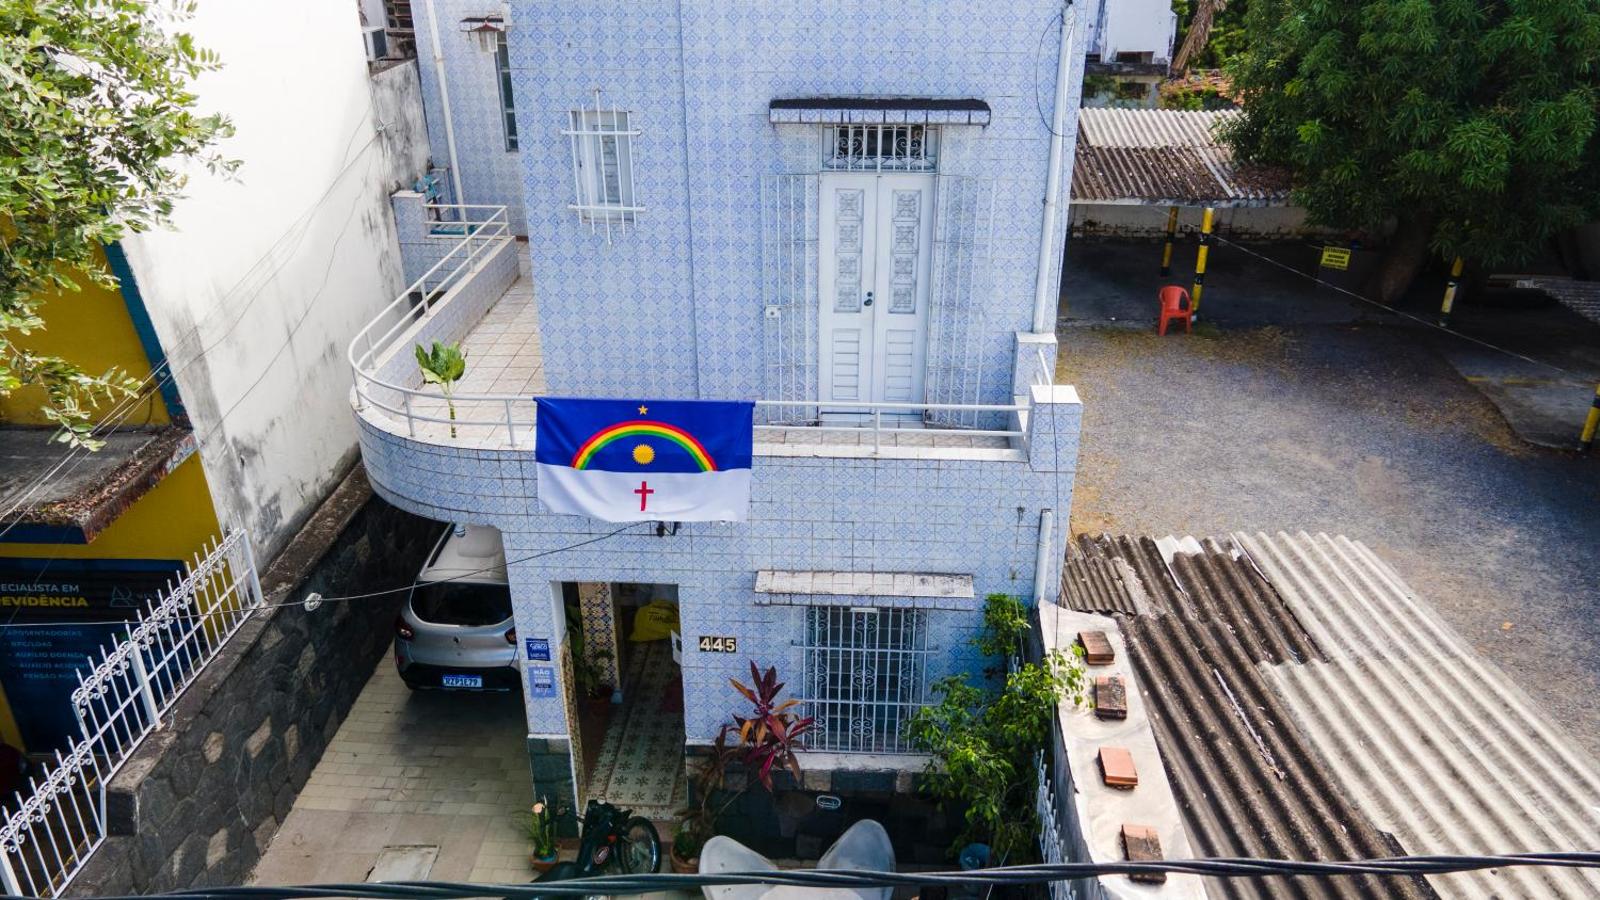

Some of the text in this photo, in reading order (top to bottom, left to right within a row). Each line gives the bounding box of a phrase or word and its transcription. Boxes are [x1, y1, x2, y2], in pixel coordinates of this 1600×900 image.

[62, 584, 79, 593] EM
[0, 594, 89, 606] EVIDÊNCIA
[700, 637, 735, 652] 445
